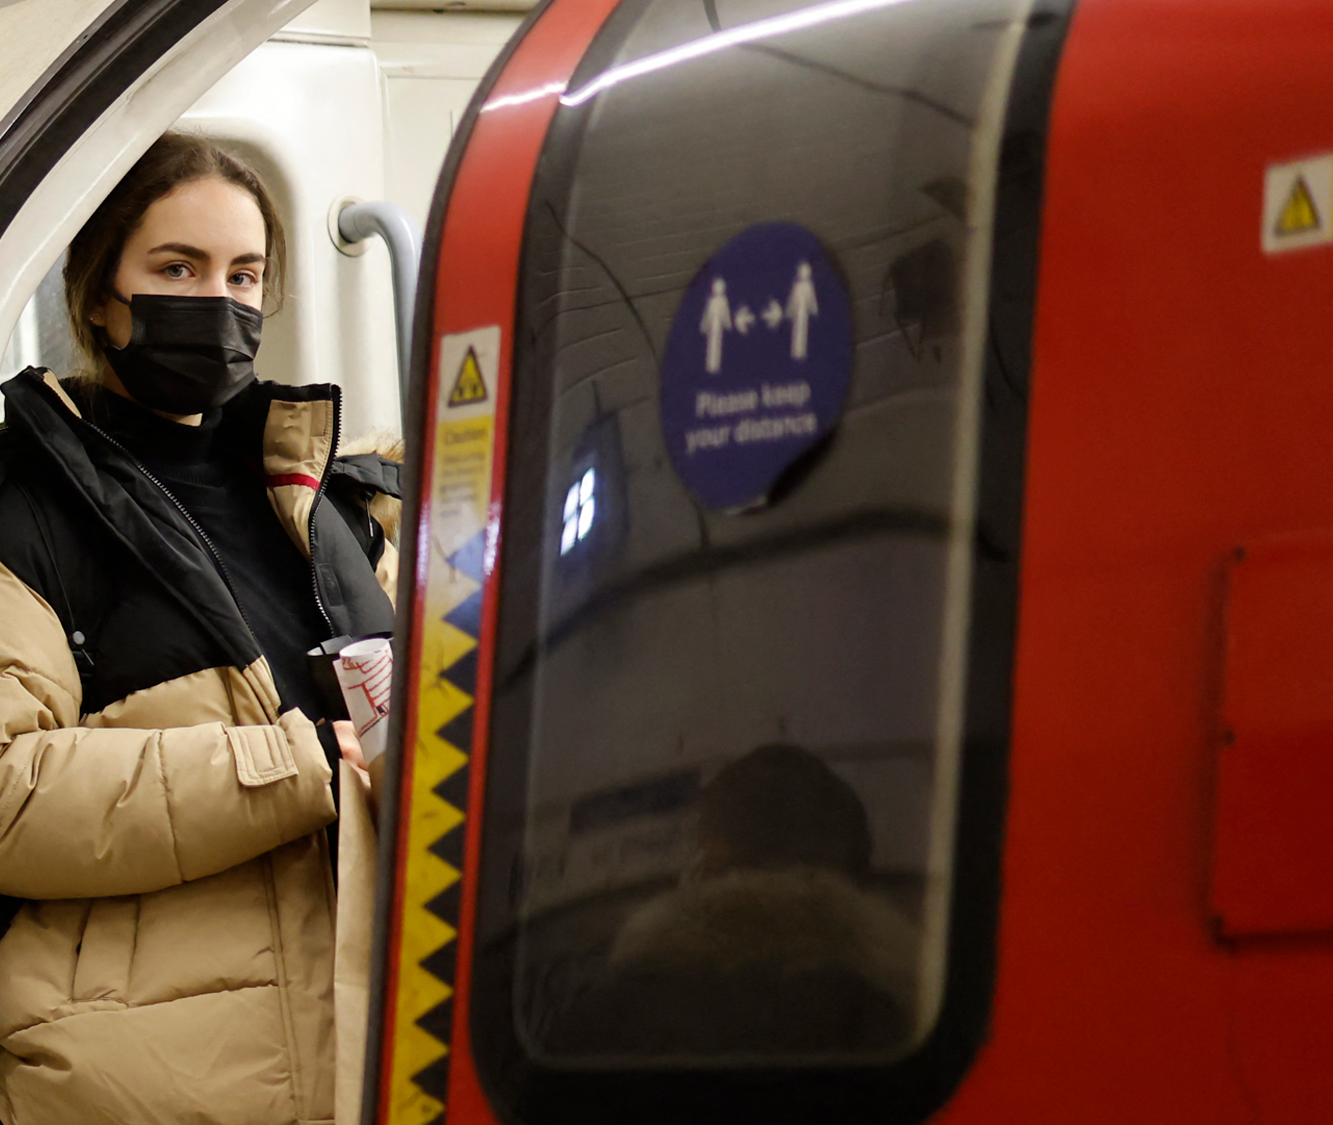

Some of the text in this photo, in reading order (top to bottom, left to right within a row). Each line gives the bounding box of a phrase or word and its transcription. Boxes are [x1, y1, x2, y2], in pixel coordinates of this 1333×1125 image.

[695, 378, 812, 418] Please keep
[685, 412, 819, 456] your distance
